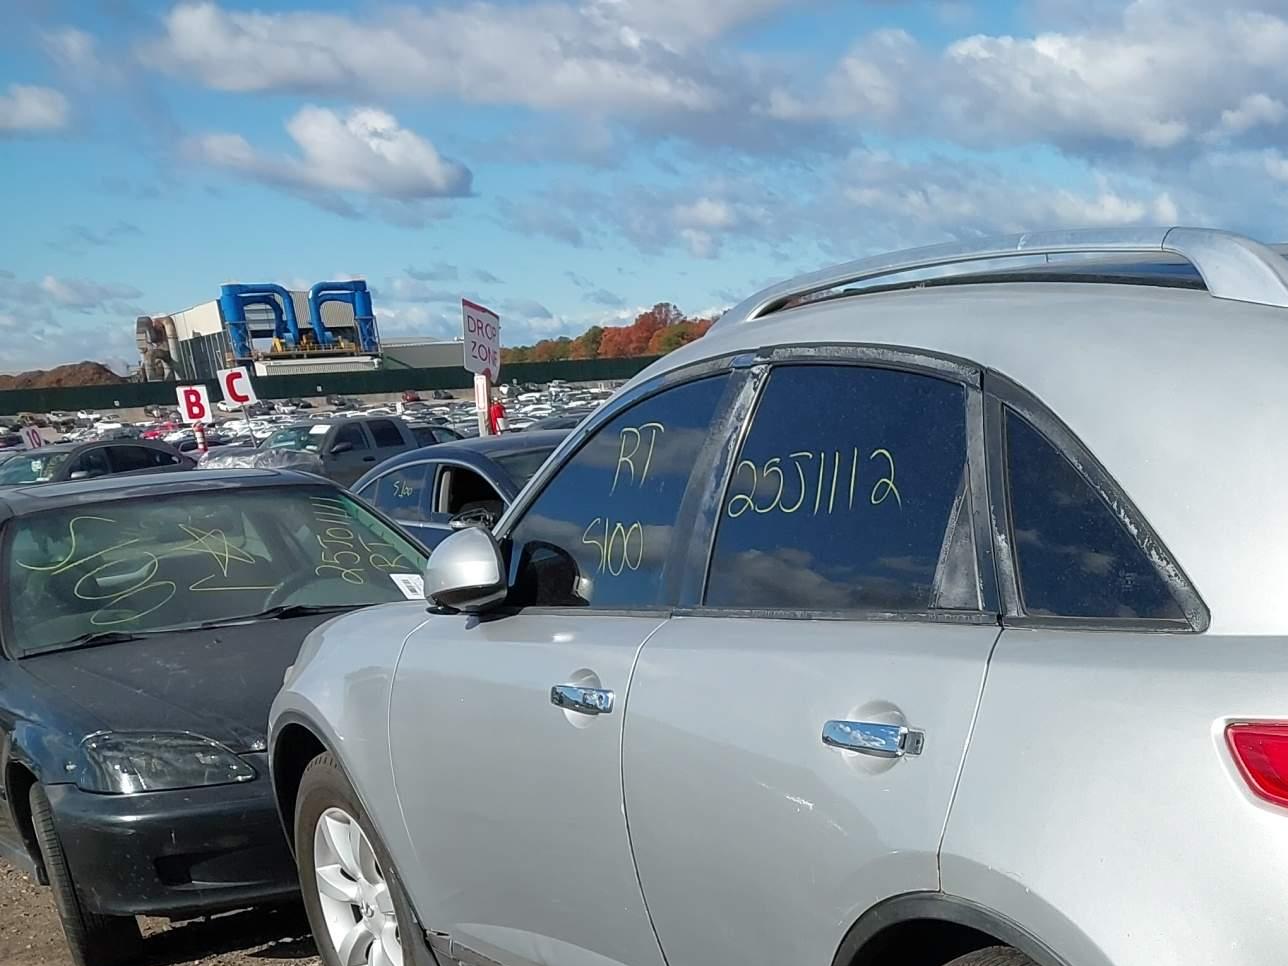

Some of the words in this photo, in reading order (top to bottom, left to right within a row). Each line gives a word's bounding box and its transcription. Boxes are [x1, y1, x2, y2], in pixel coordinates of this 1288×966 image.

[467, 315, 497, 340] DROP
[471, 341, 498, 366] ZONE
[225, 371, 250, 402] C
[183, 389, 206, 419] B
[26, 428, 42, 448] 10
[609, 422, 664, 497] RT
[582, 516, 644, 577] S100
